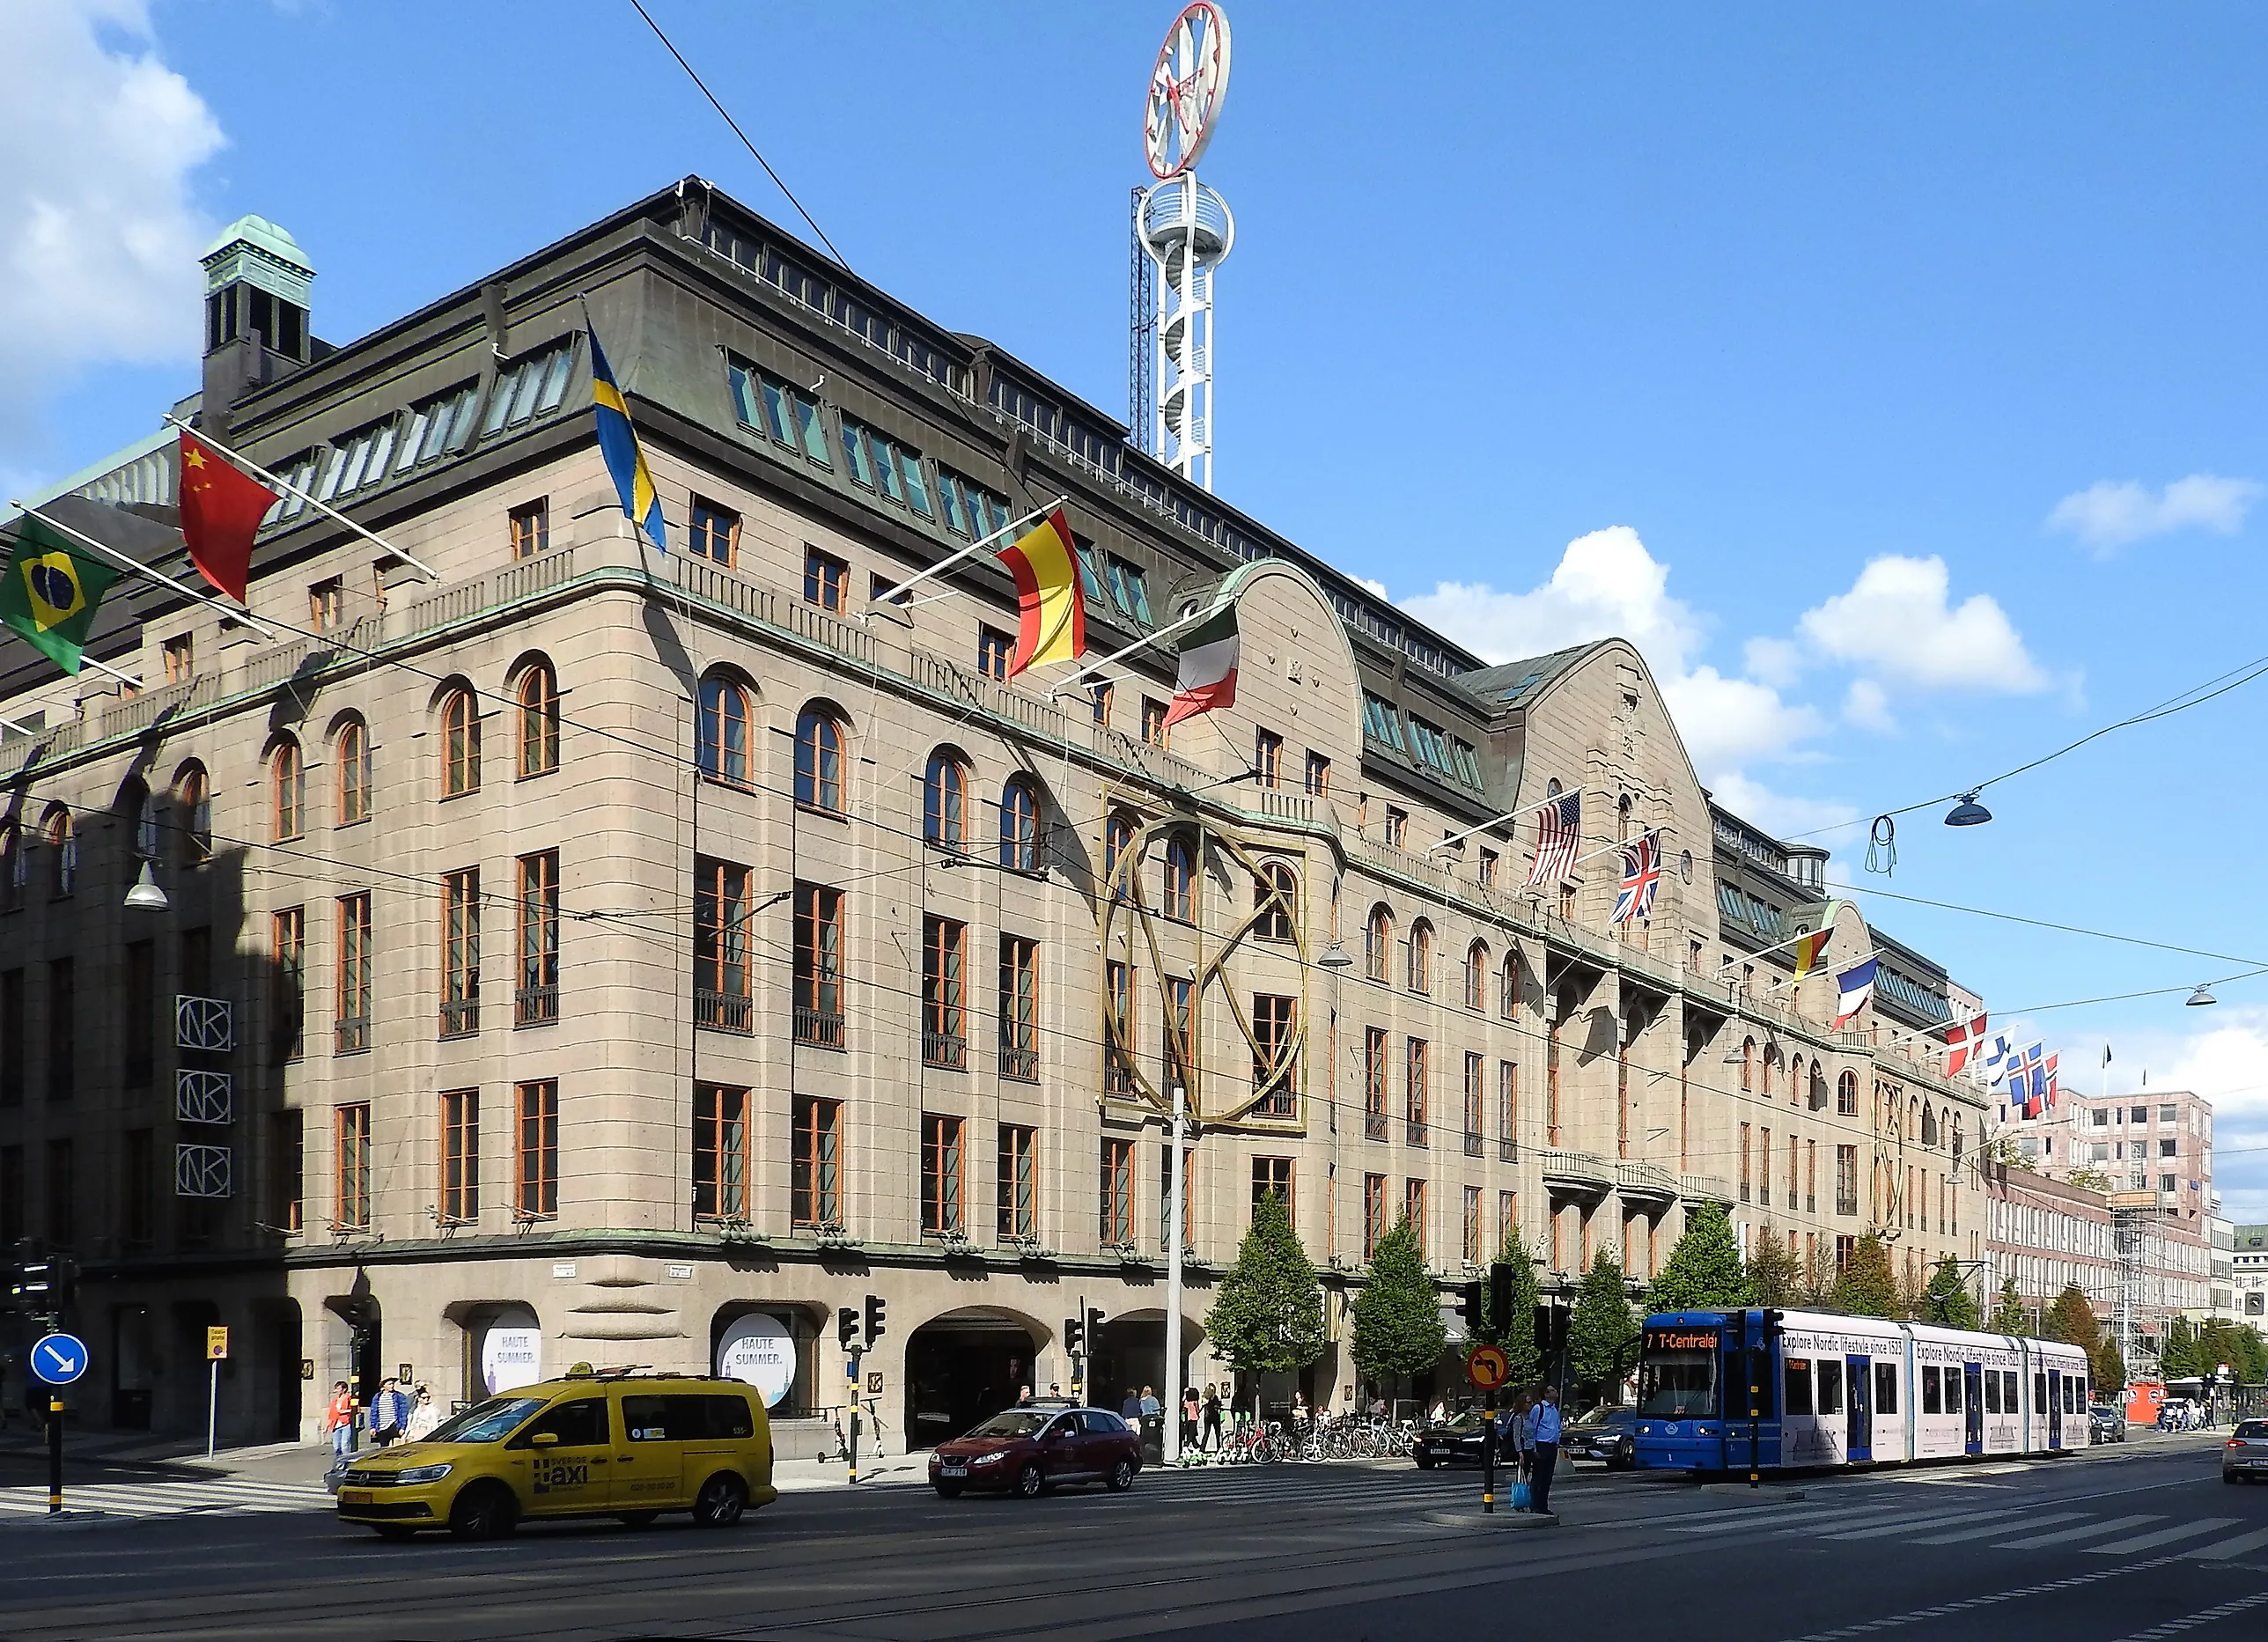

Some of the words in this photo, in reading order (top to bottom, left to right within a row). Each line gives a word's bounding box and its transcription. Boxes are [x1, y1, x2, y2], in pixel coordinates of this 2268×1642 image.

[183, 998, 229, 1049] NK
[183, 1072, 229, 1122] NK
[183, 1146, 229, 1196] NK
[502, 1336, 529, 1348] HAUTE
[741, 1338, 775, 1349] HAUTE
[1647, 1333, 1653, 1349] 7
[1782, 1332, 1812, 1353] Explore
[1814, 1335, 1838, 1351] Nordic
[1840, 1336, 1869, 1353] lifestyle
[1870, 1339, 1887, 1354] since
[735, 1353, 783, 1365] SUMMER.
[1917, 1342, 1942, 1365] Explore
[1943, 1345, 1964, 1363] Nordic
[1966, 1347, 1990, 1369] lifestyle
[1992, 1350, 2007, 1366] since
